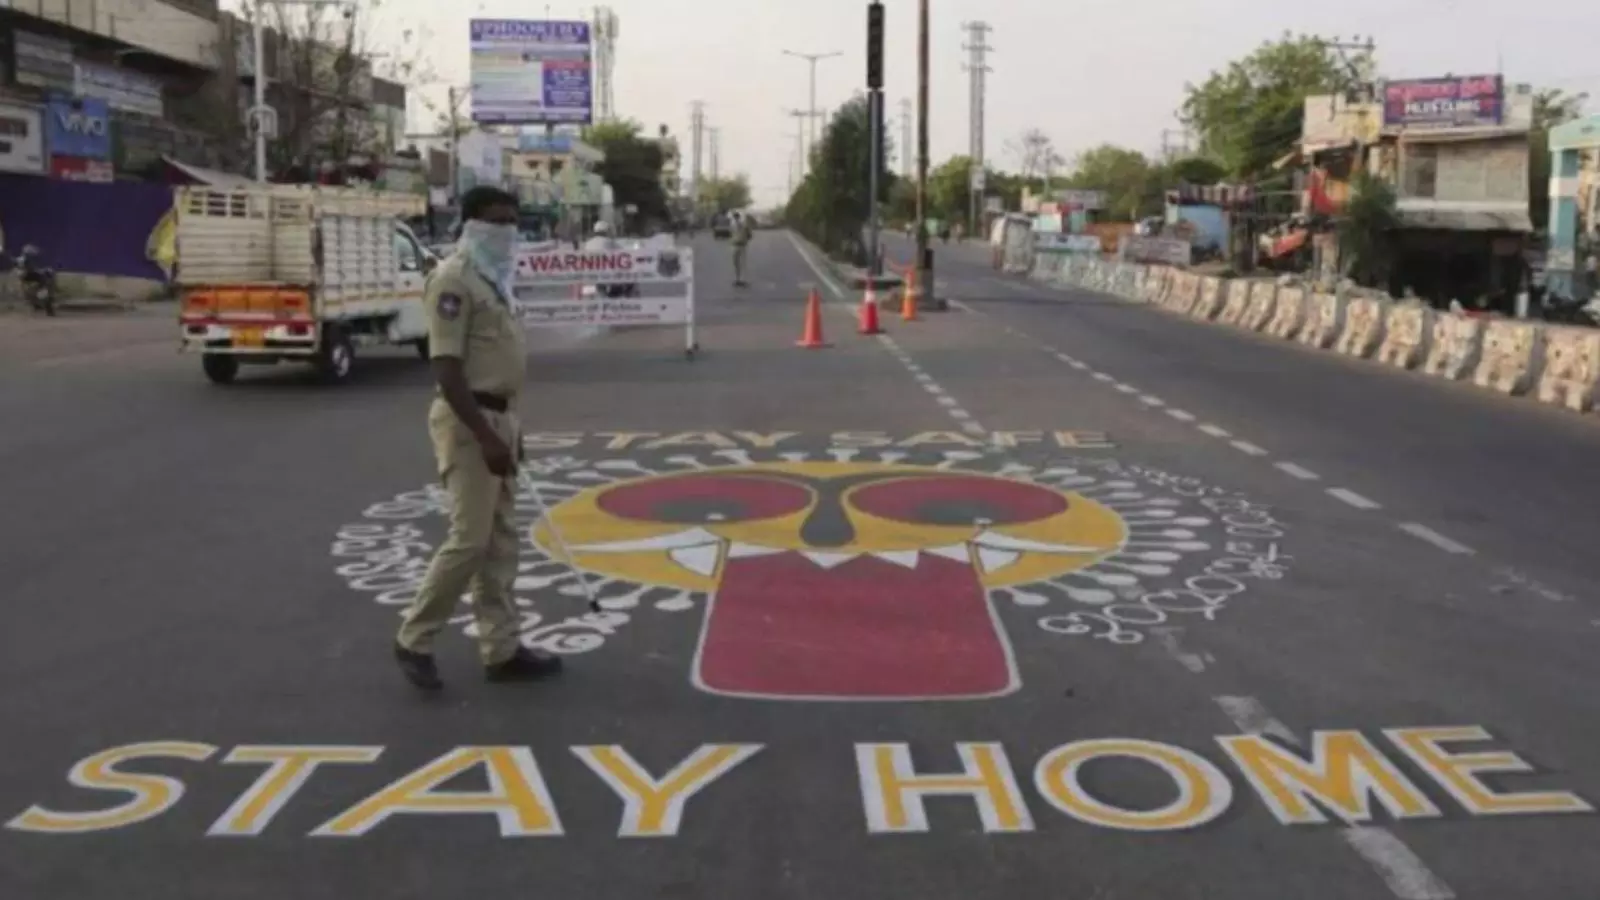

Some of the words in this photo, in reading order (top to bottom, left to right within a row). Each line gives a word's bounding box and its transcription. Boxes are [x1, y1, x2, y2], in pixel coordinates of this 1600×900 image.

[529, 253, 633, 272] WARNING
[522, 430, 800, 449] STAY
[829, 430, 1117, 448] SAFE
[4, 740, 767, 837] STAY
[854, 725, 1595, 833] HOME
